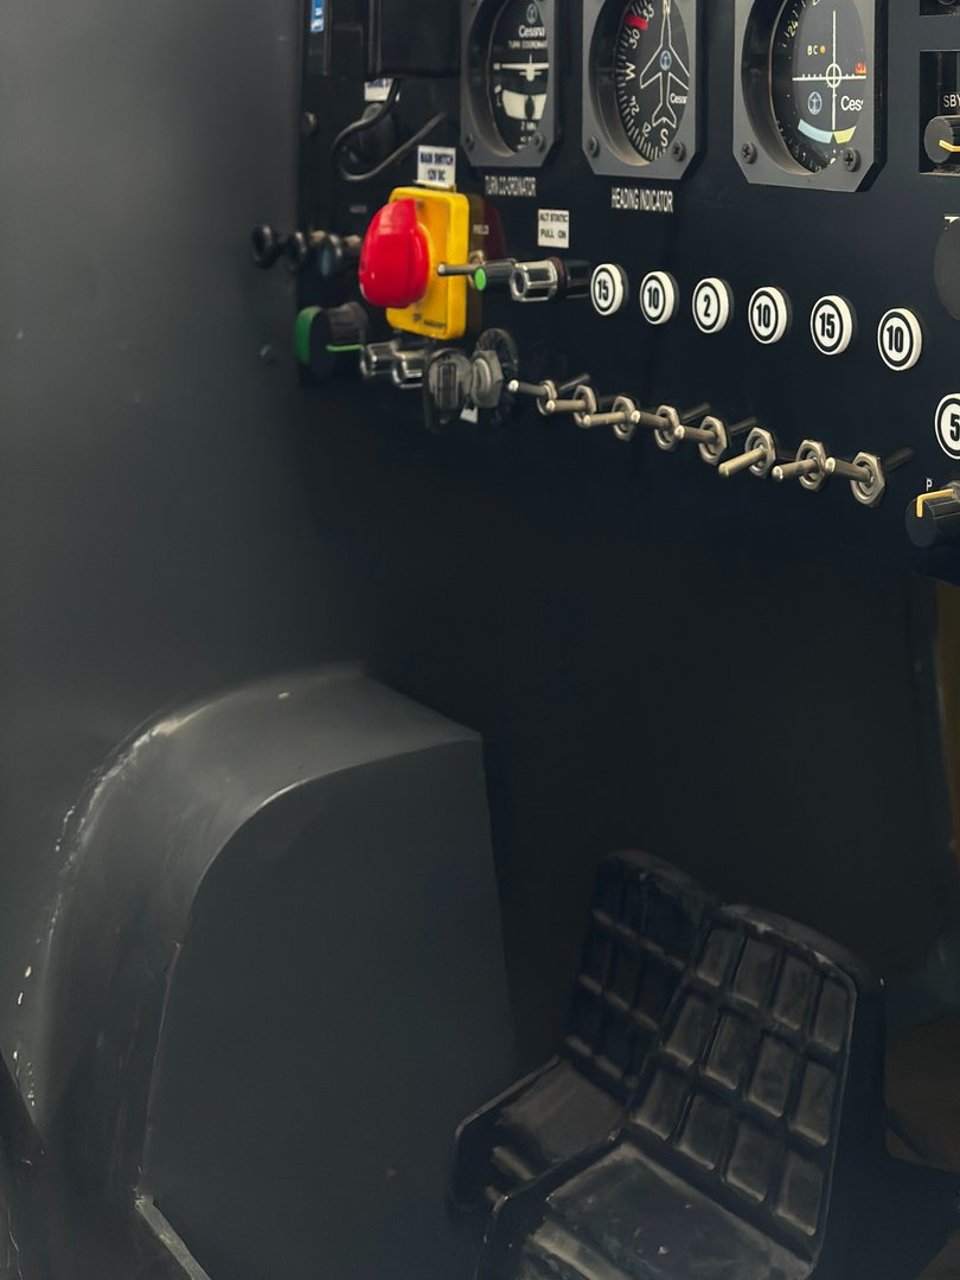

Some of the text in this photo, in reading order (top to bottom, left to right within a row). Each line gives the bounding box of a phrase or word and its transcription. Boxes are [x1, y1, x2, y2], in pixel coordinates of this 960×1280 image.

[660, 128, 668, 146] S
[611, 188, 639, 210] HEADING
[540, 228, 566, 239] PULL ON
[597, 280, 609, 300] 15
[647, 287, 659, 309] 10
[703, 295, 711, 317] 2
[756, 303, 770, 327] 10
[819, 313, 834, 338] 15
[886, 327, 903, 352] 10
[950, 414, 960, 442] 5
[926, 478, 933, 491] P
